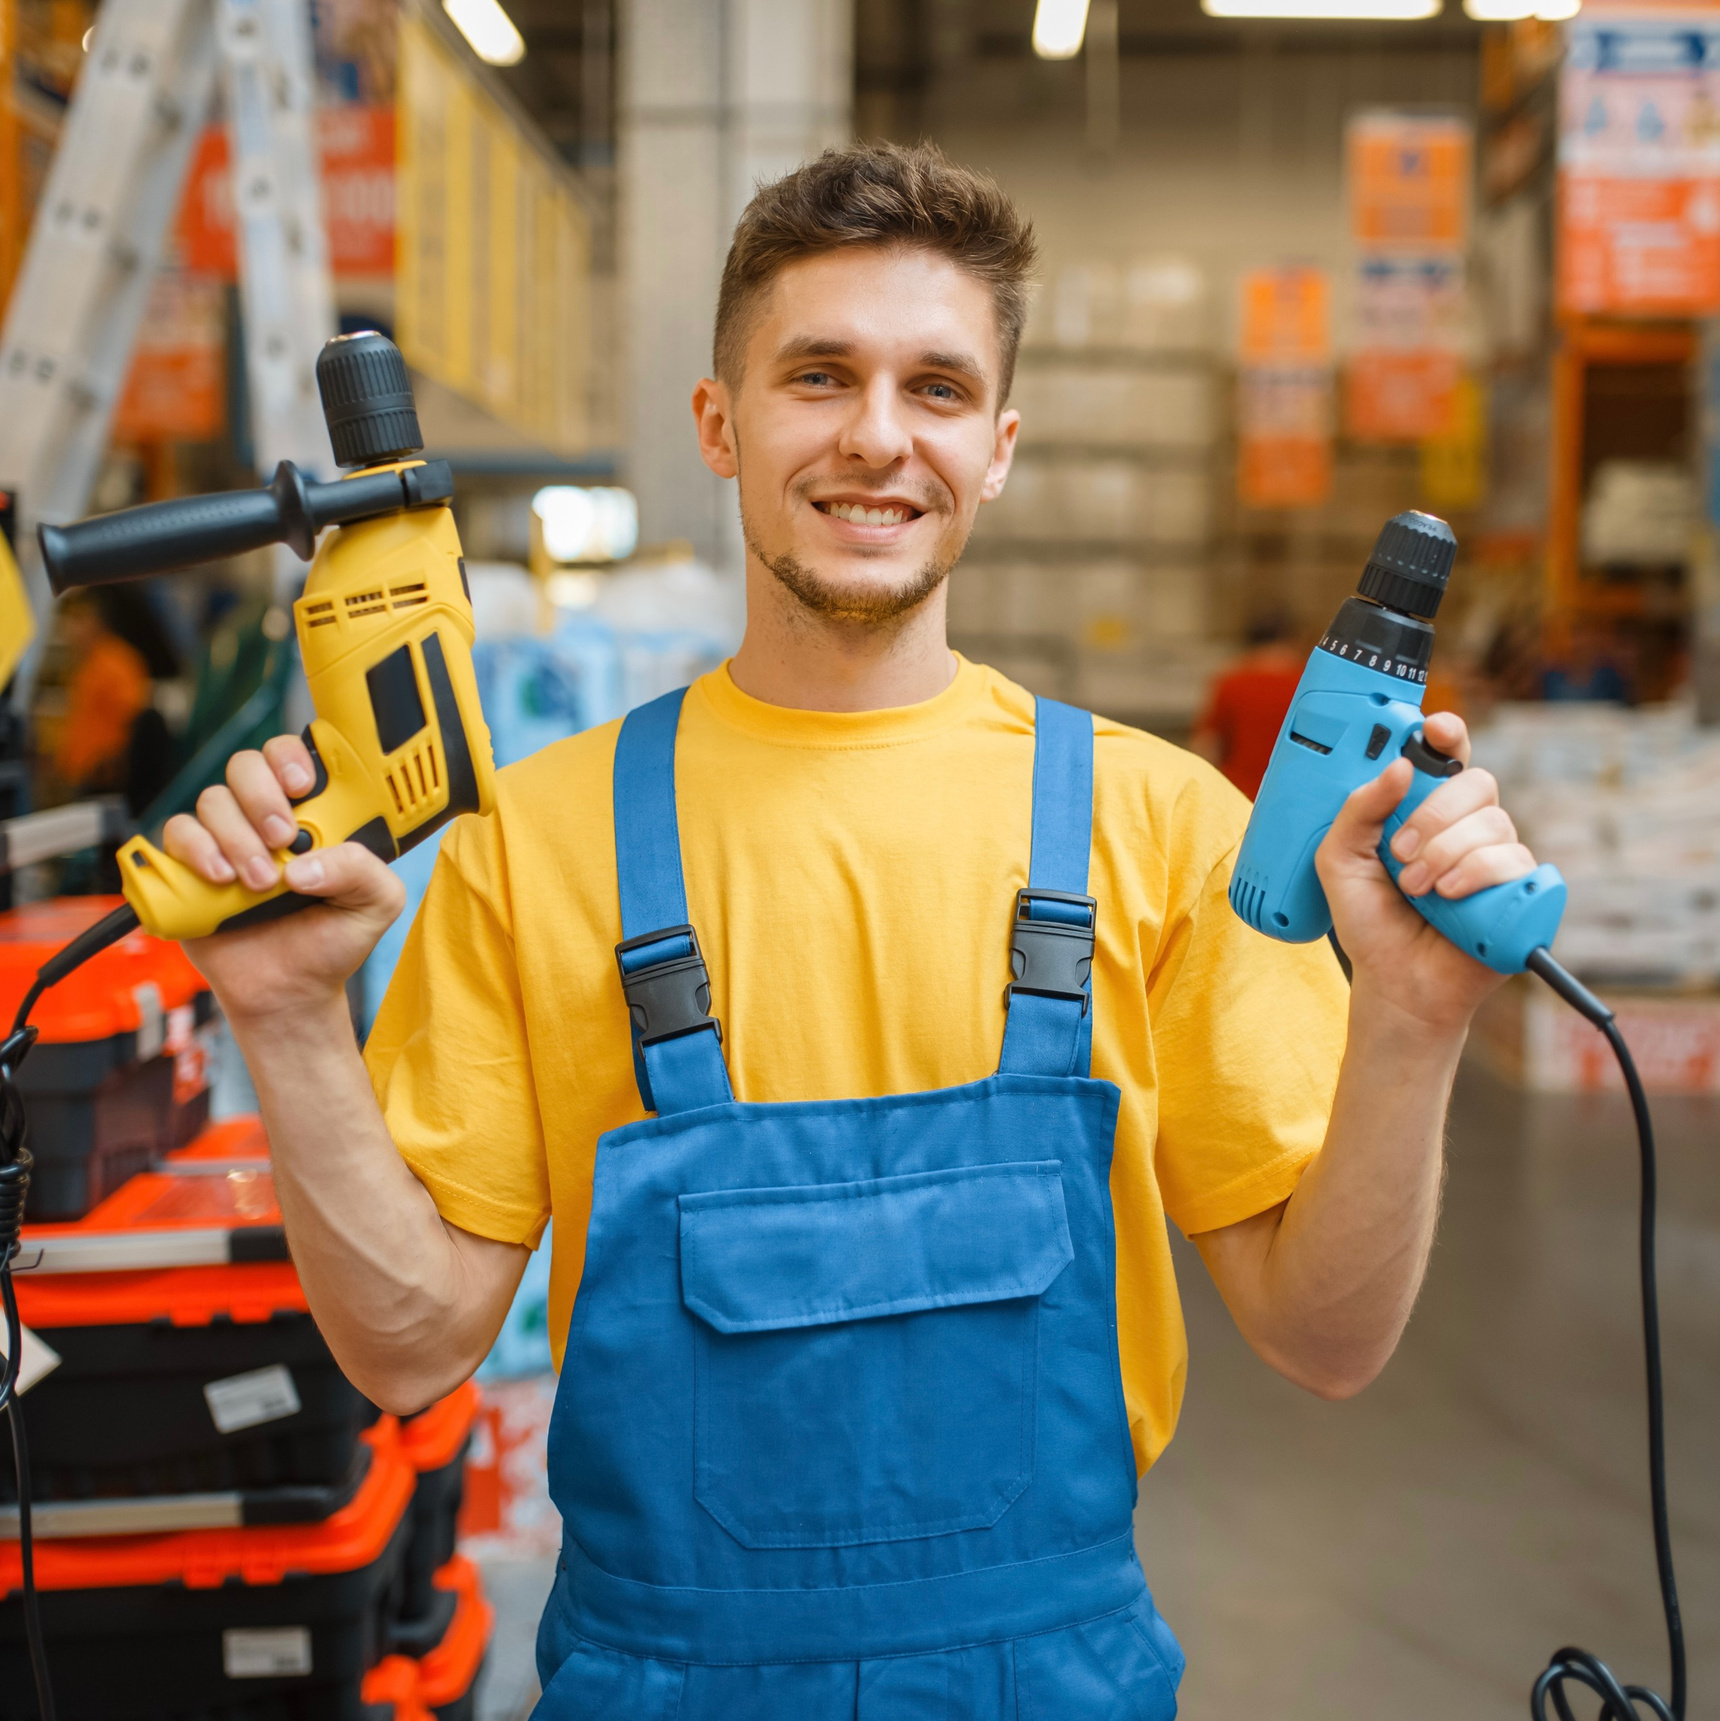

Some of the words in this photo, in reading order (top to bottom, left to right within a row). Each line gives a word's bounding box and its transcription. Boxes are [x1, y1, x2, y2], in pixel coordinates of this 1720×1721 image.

[1330, 640, 1338, 651] 5
[1340, 644, 1348, 655] 6
[1353, 649, 1363, 660] 7
[1369, 655, 1377, 667] 8
[1383, 660, 1391, 671] 9
[1396, 663, 1407, 677] 10
[1408, 667, 1417, 679] 11
[1418, 670, 1425, 682] 12
